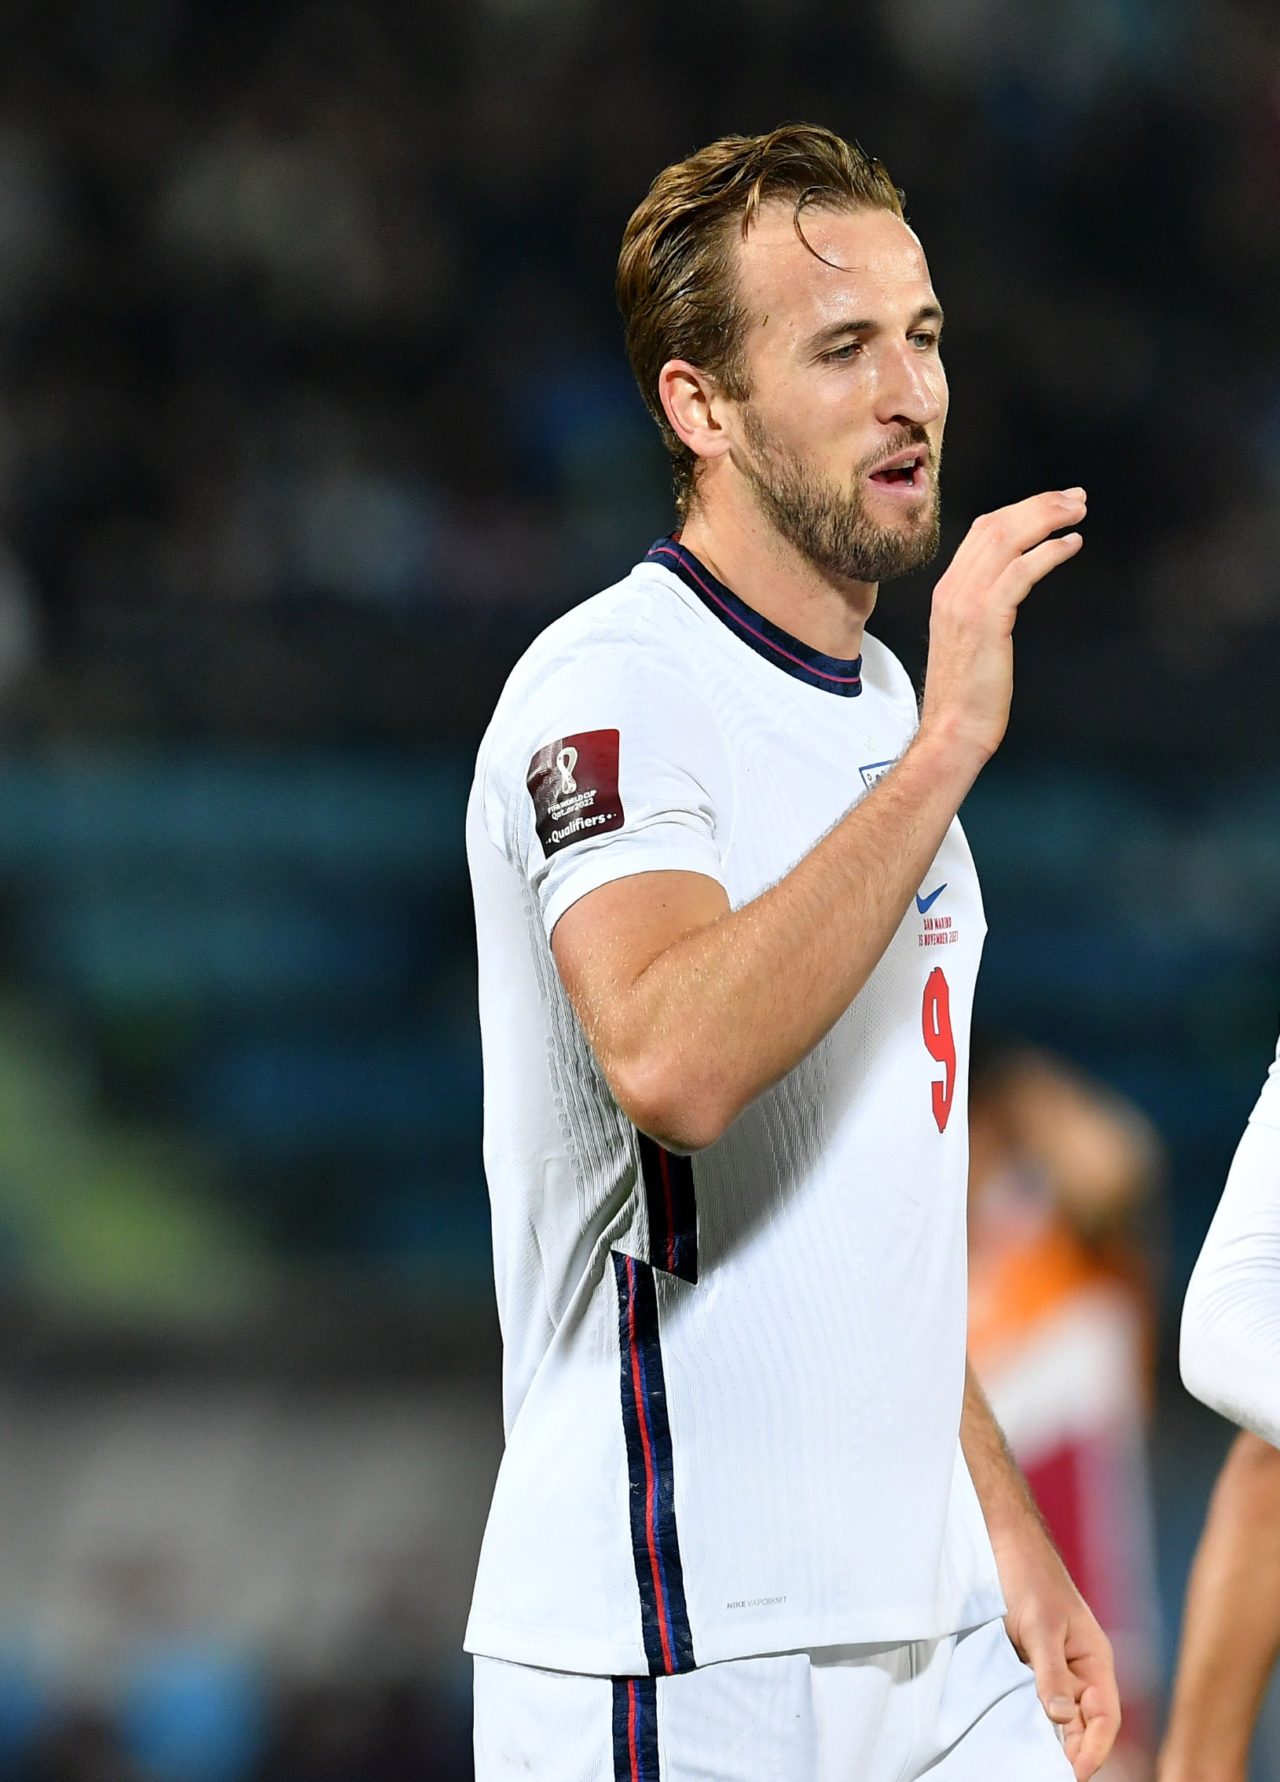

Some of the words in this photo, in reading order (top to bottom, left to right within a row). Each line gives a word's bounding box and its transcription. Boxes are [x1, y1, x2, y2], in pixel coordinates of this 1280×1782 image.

[561, 794, 583, 808] WORLD
[584, 789, 597, 799] CUP
[552, 814, 606, 843] Qualifiers
[922, 966, 956, 1134] 9
[727, 1600, 746, 1609] NIKE
